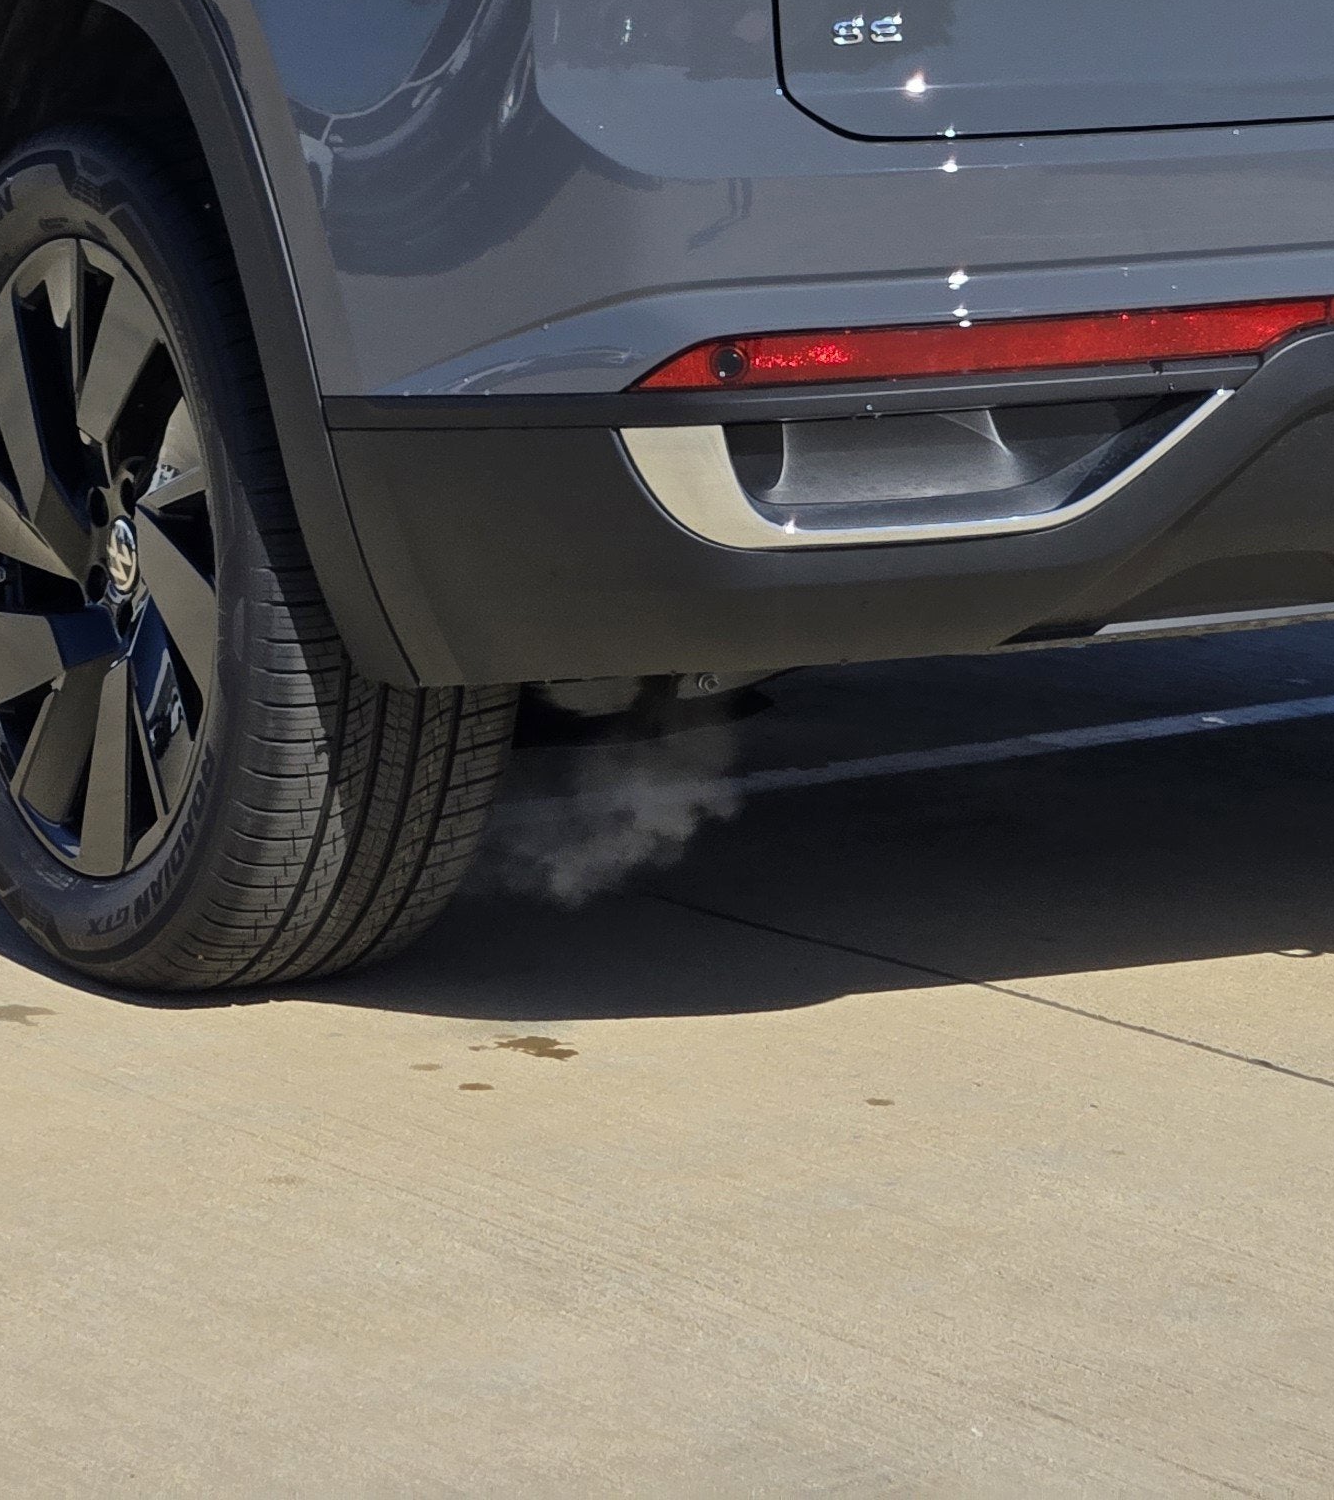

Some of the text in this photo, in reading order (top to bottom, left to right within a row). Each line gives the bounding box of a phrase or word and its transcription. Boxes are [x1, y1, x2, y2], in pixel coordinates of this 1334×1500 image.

[832, 14, 903, 46] SE
[87, 740, 216, 936] ROADIAN GTX
